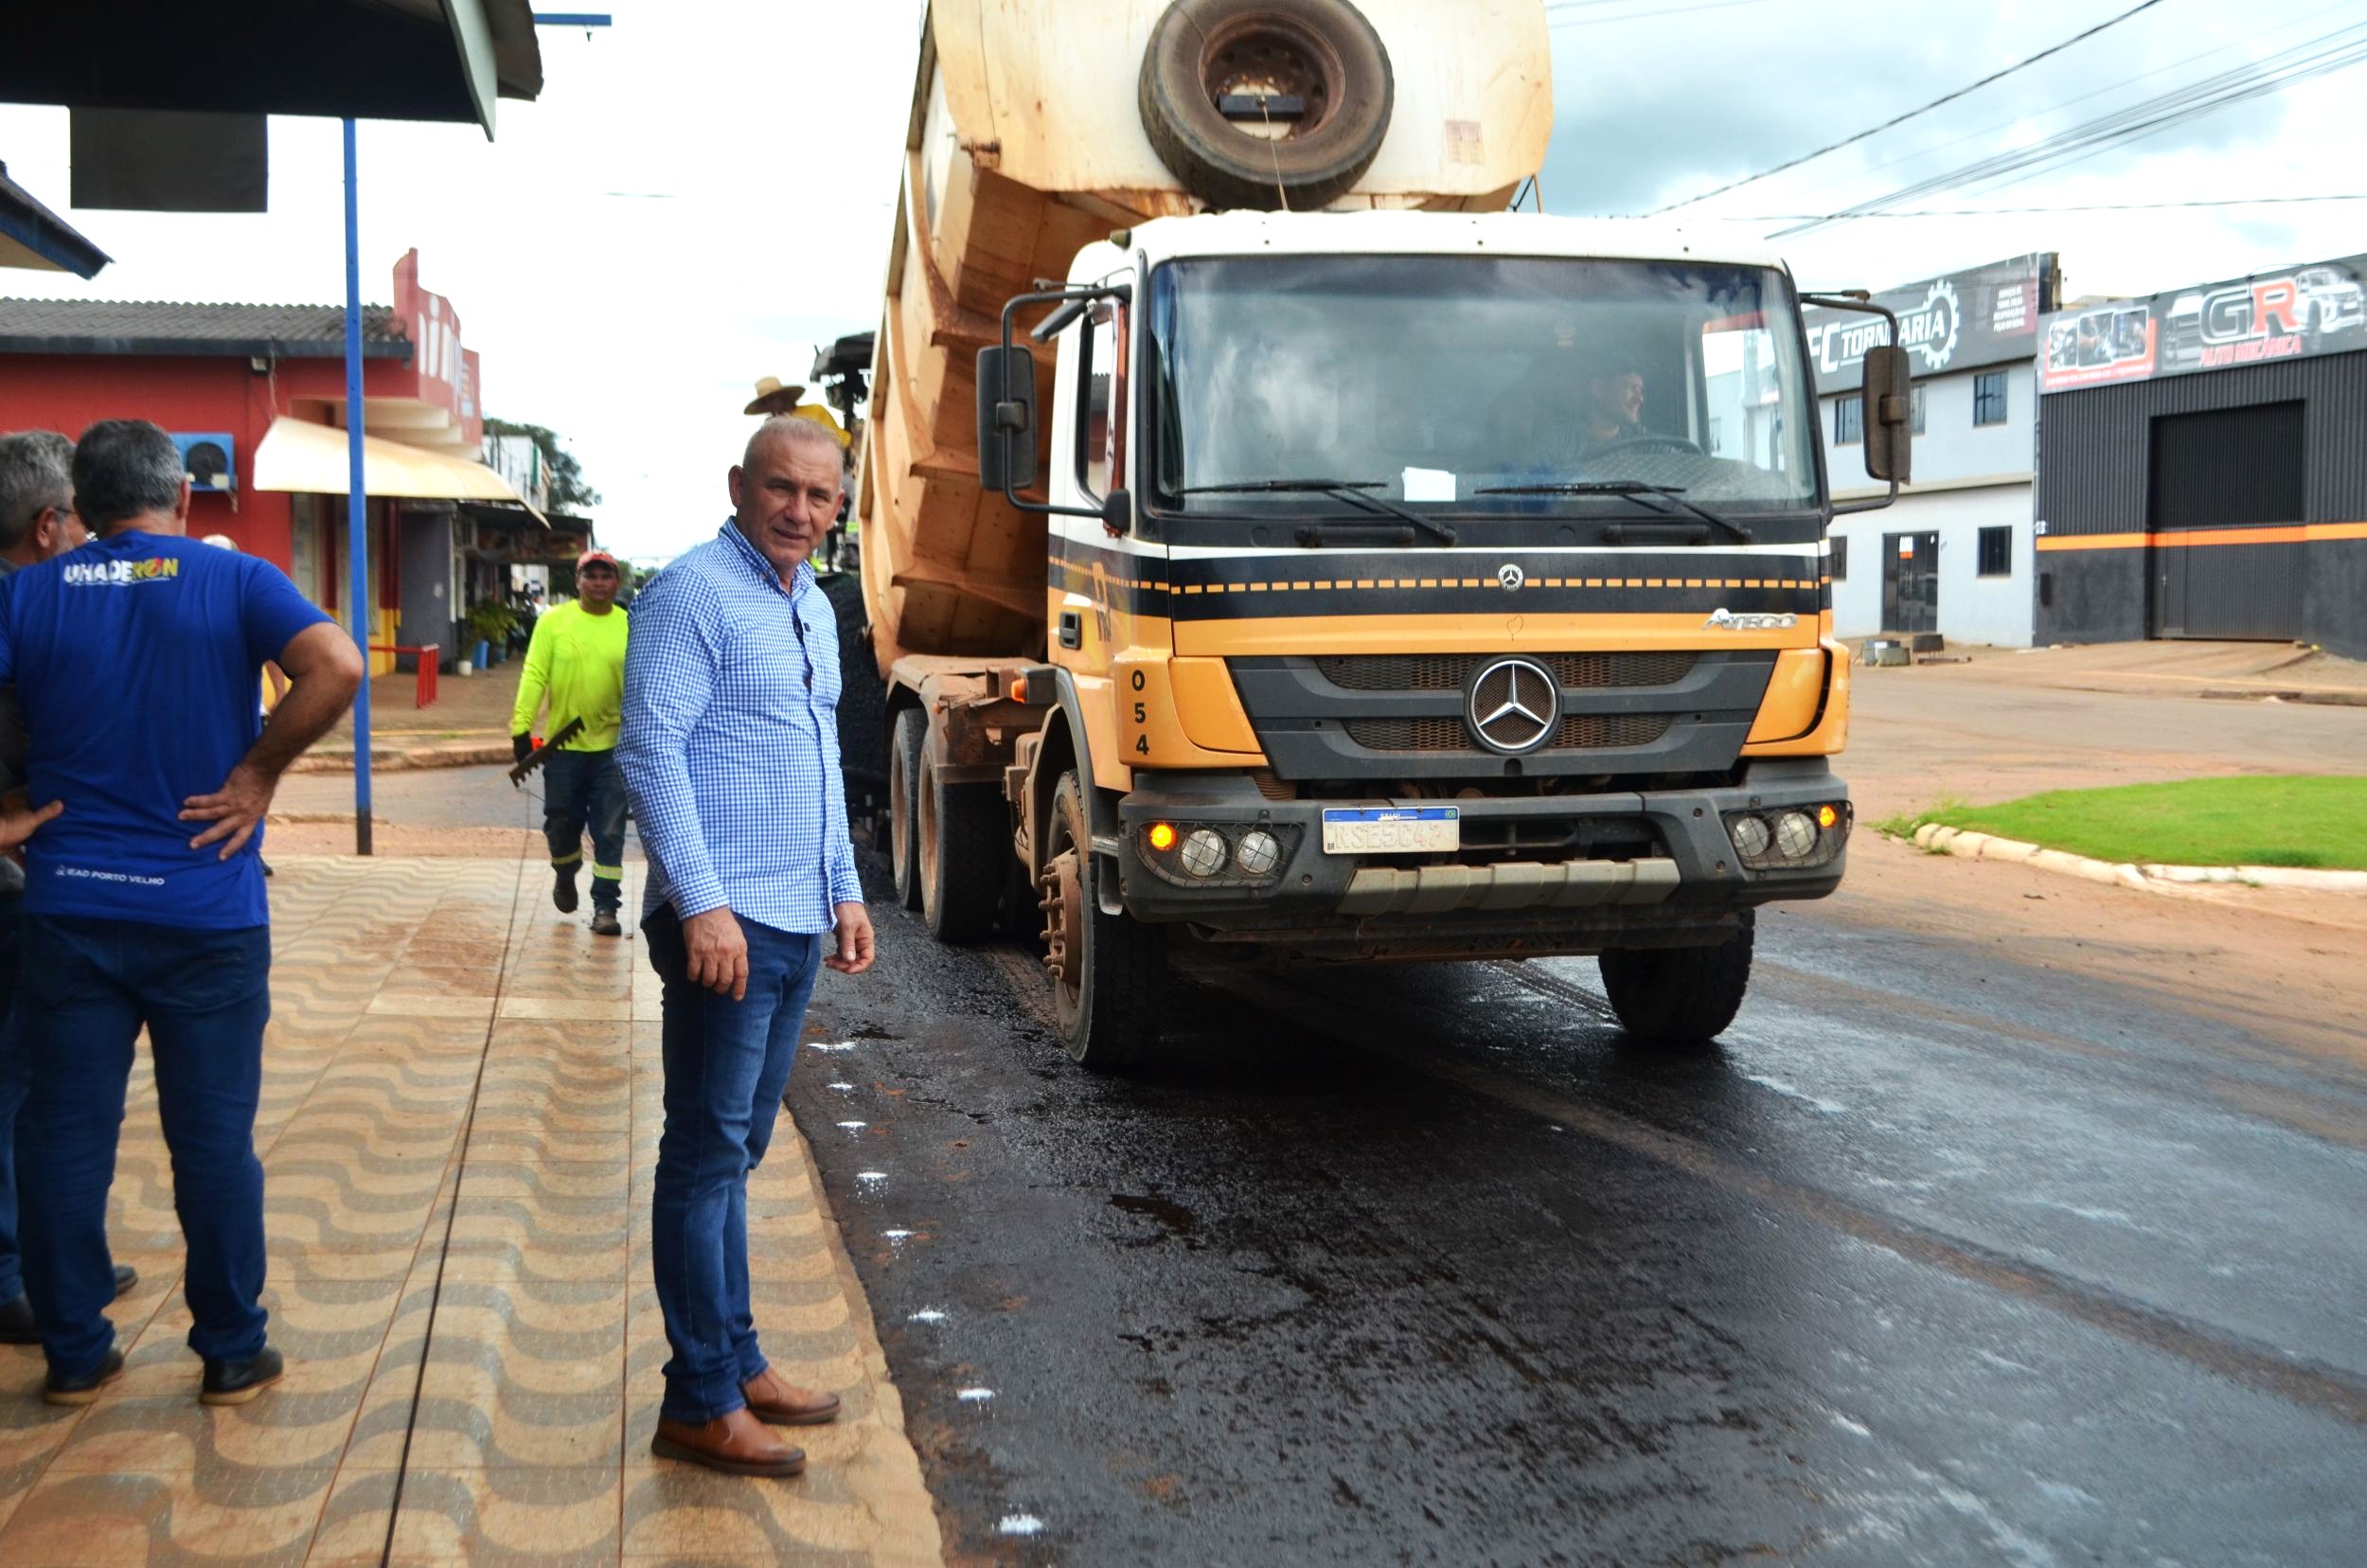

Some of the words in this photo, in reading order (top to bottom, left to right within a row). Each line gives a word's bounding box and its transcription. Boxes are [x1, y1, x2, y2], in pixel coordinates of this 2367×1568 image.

[1841, 310, 1946, 359] TORNARIA
[2198, 277, 2300, 344] GR
[91, 870, 128, 882] PORTO
[128, 875, 165, 886] VELHO
